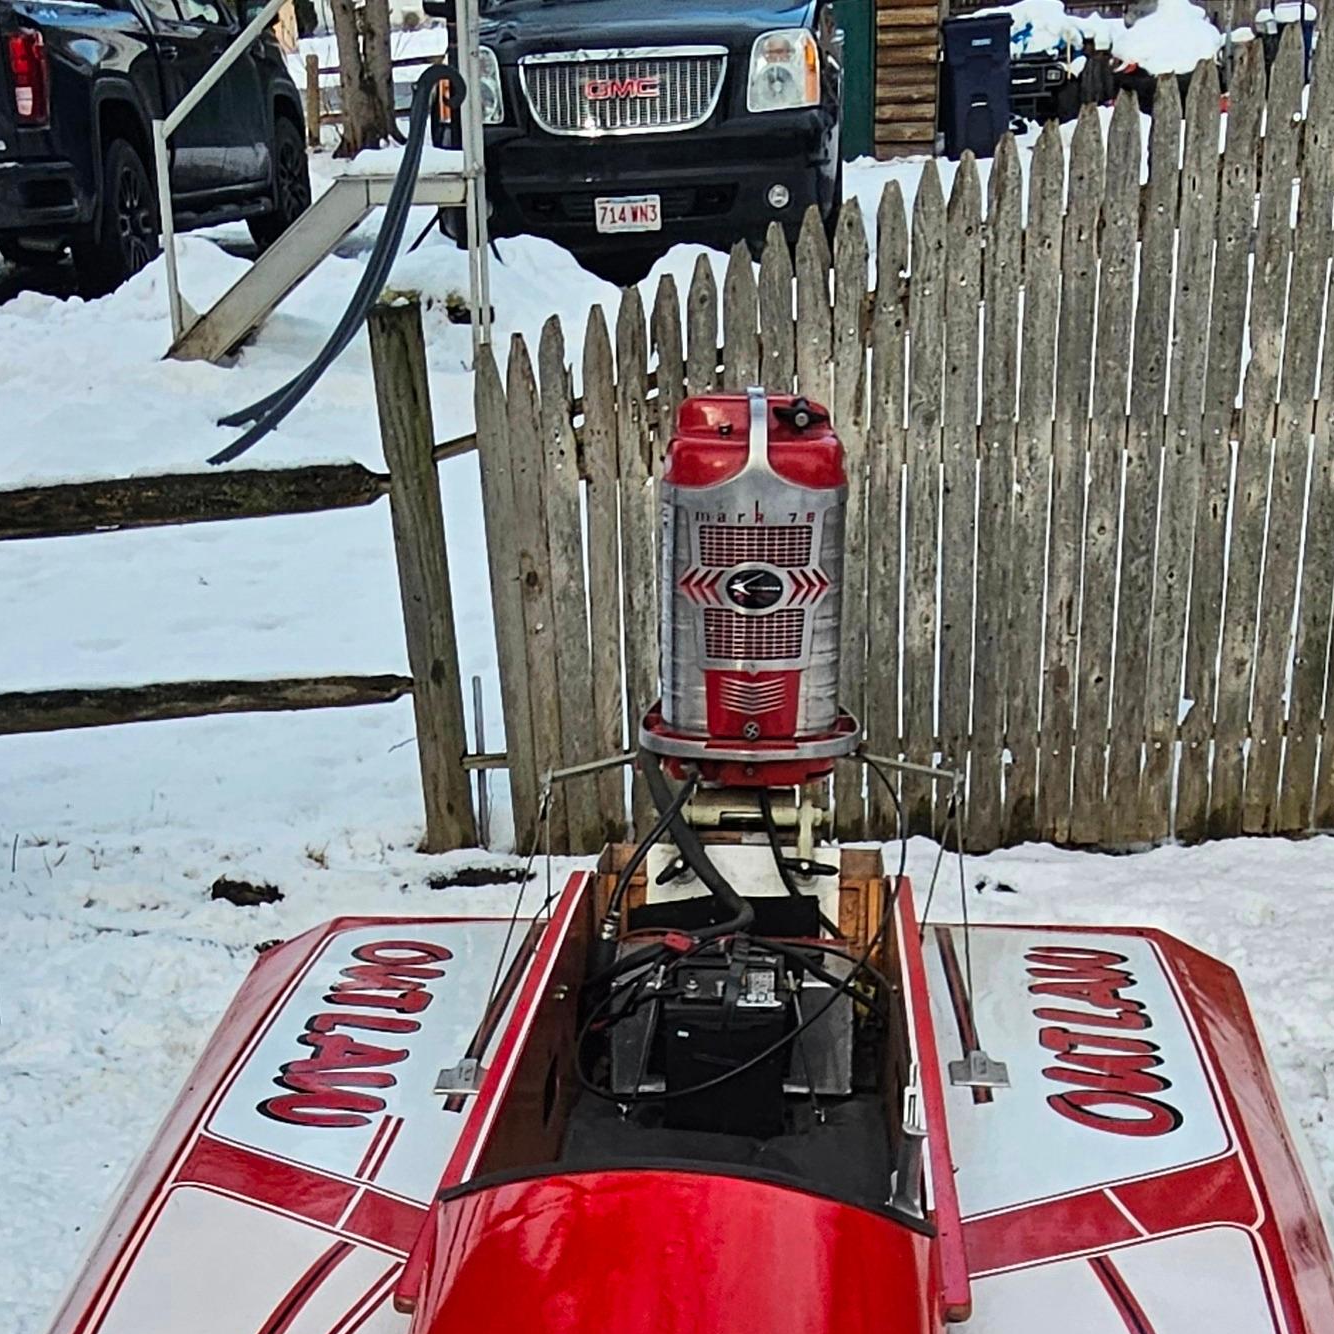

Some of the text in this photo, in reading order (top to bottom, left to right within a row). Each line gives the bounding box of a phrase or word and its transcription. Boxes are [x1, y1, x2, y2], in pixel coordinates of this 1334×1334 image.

[586, 78, 660, 100] GMC
[599, 204, 658, 224] 714 WN3
[256, 940, 453, 1128] OUTLAW
[1023, 946, 1184, 1138] OUTLAW
